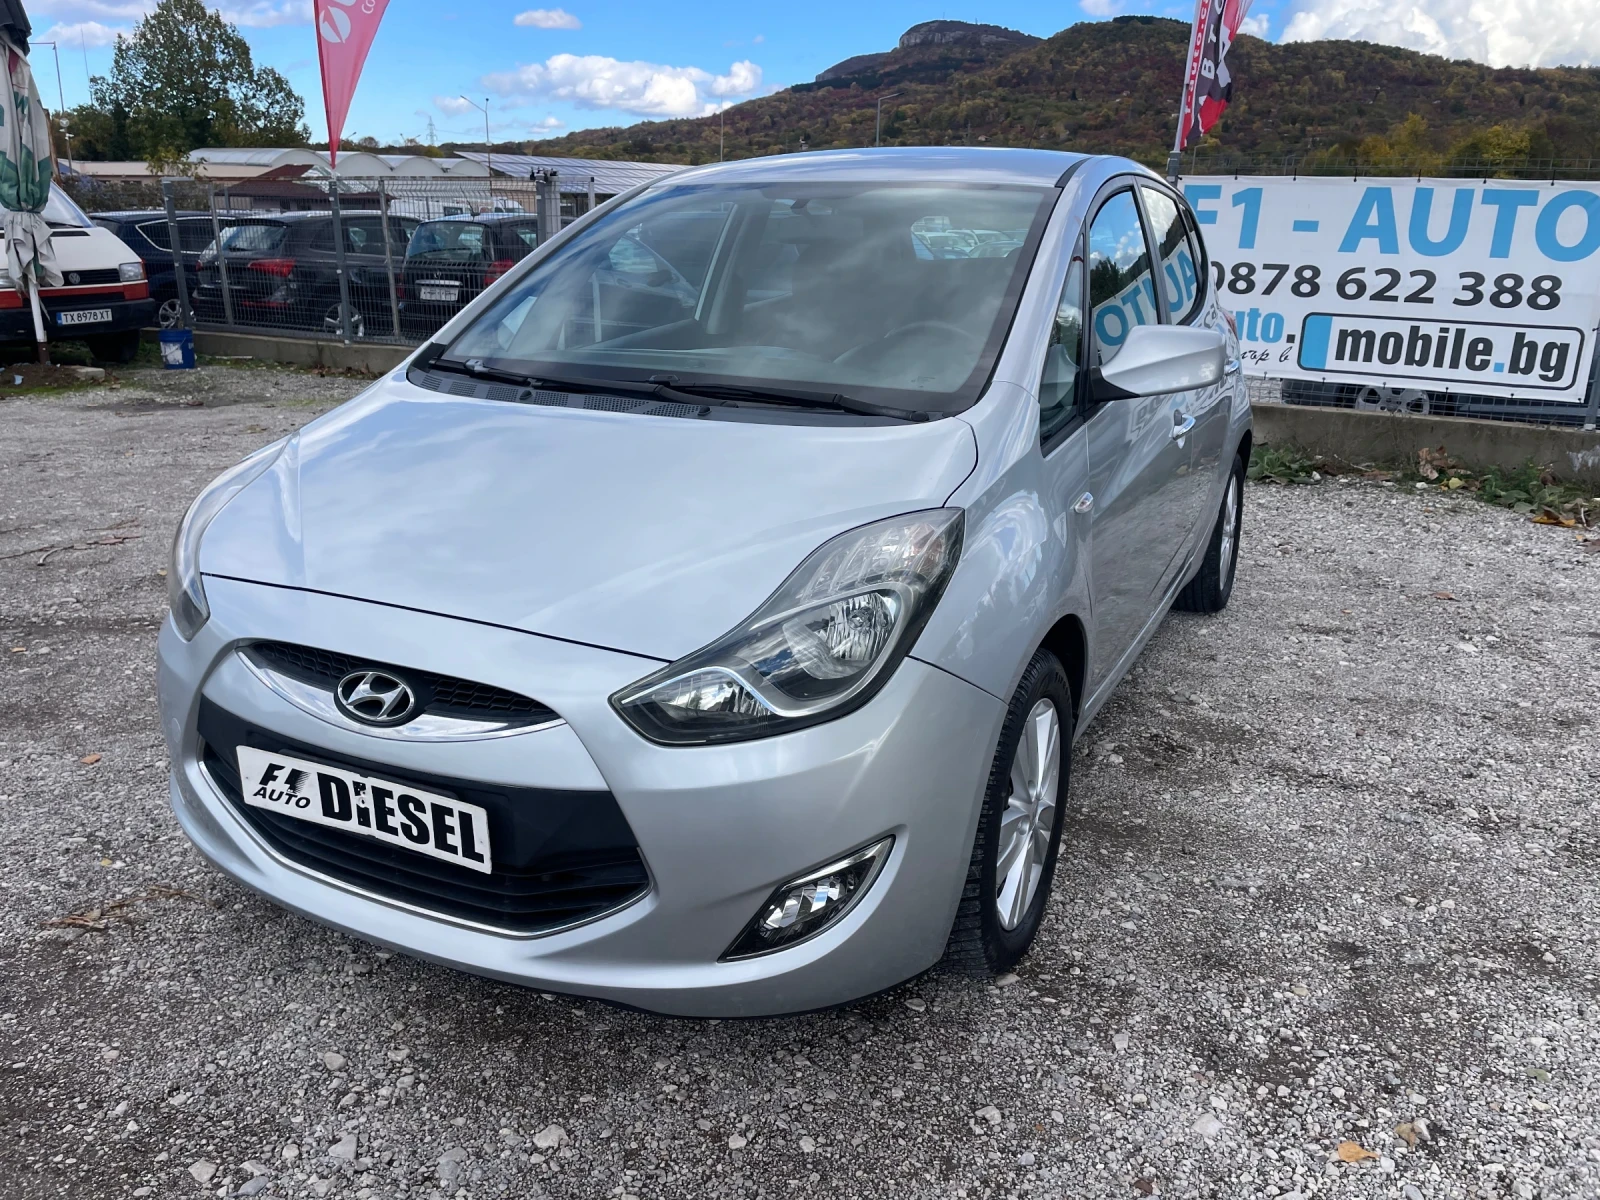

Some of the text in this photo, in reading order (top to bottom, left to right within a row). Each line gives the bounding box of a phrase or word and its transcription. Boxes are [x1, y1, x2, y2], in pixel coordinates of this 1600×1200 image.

[1338, 187, 1600, 263] AUTO
[1335, 266, 1437, 304] 622
[1452, 271, 1563, 311] 388
[63, 310, 110, 323] TX 8978 XT
[1334, 325, 1570, 383] mobile.bg
[252, 786, 311, 809] AUTO
[258, 762, 312, 794] F1
[316, 771, 485, 864] DIESEL
